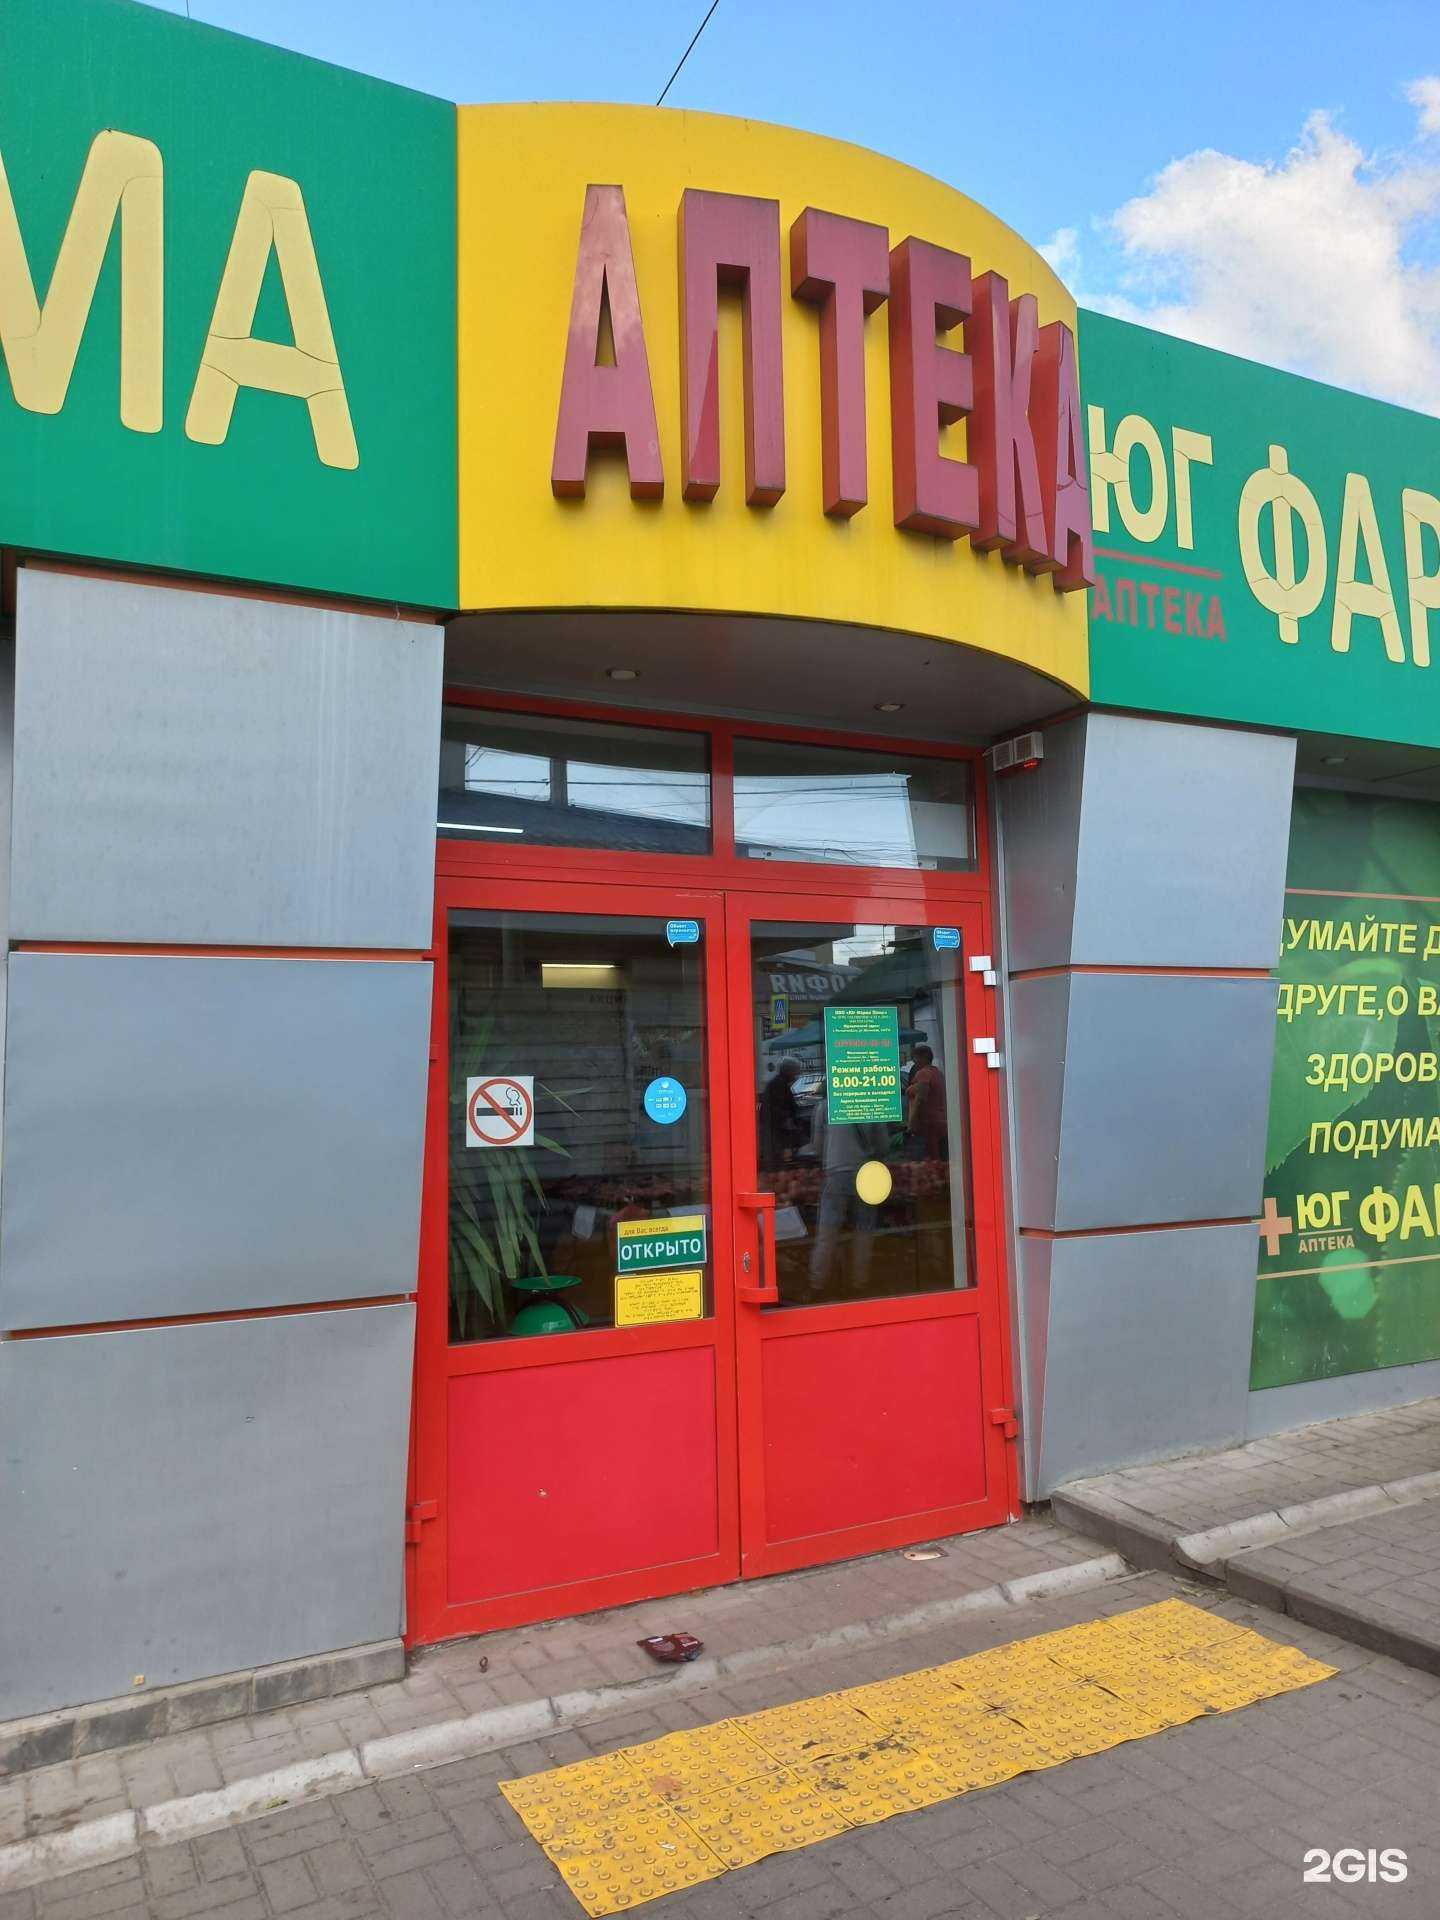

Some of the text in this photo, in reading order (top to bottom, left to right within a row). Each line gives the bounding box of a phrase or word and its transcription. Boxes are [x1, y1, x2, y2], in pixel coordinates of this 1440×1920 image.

[0, 129, 360, 470] МА
[551, 183, 1095, 592] АПТЕКА
[1087, 403, 1440, 668] ЮГ ФАР
[1091, 575, 1228, 644] АПТЕКА
[1279, 914, 1417, 957] УМАЙТЕ
[832, 1075, 896, 1088] 8.00-21.00
[863, 1065, 896, 1074] работы:
[1305, 1052, 1440, 1093] ЗДОРОВ
[1296, 1183, 1440, 1243] ЮГ ФА
[621, 1238, 701, 1261] ОТКРЫТО
[1298, 1234, 1355, 1254] АПТЕКА
